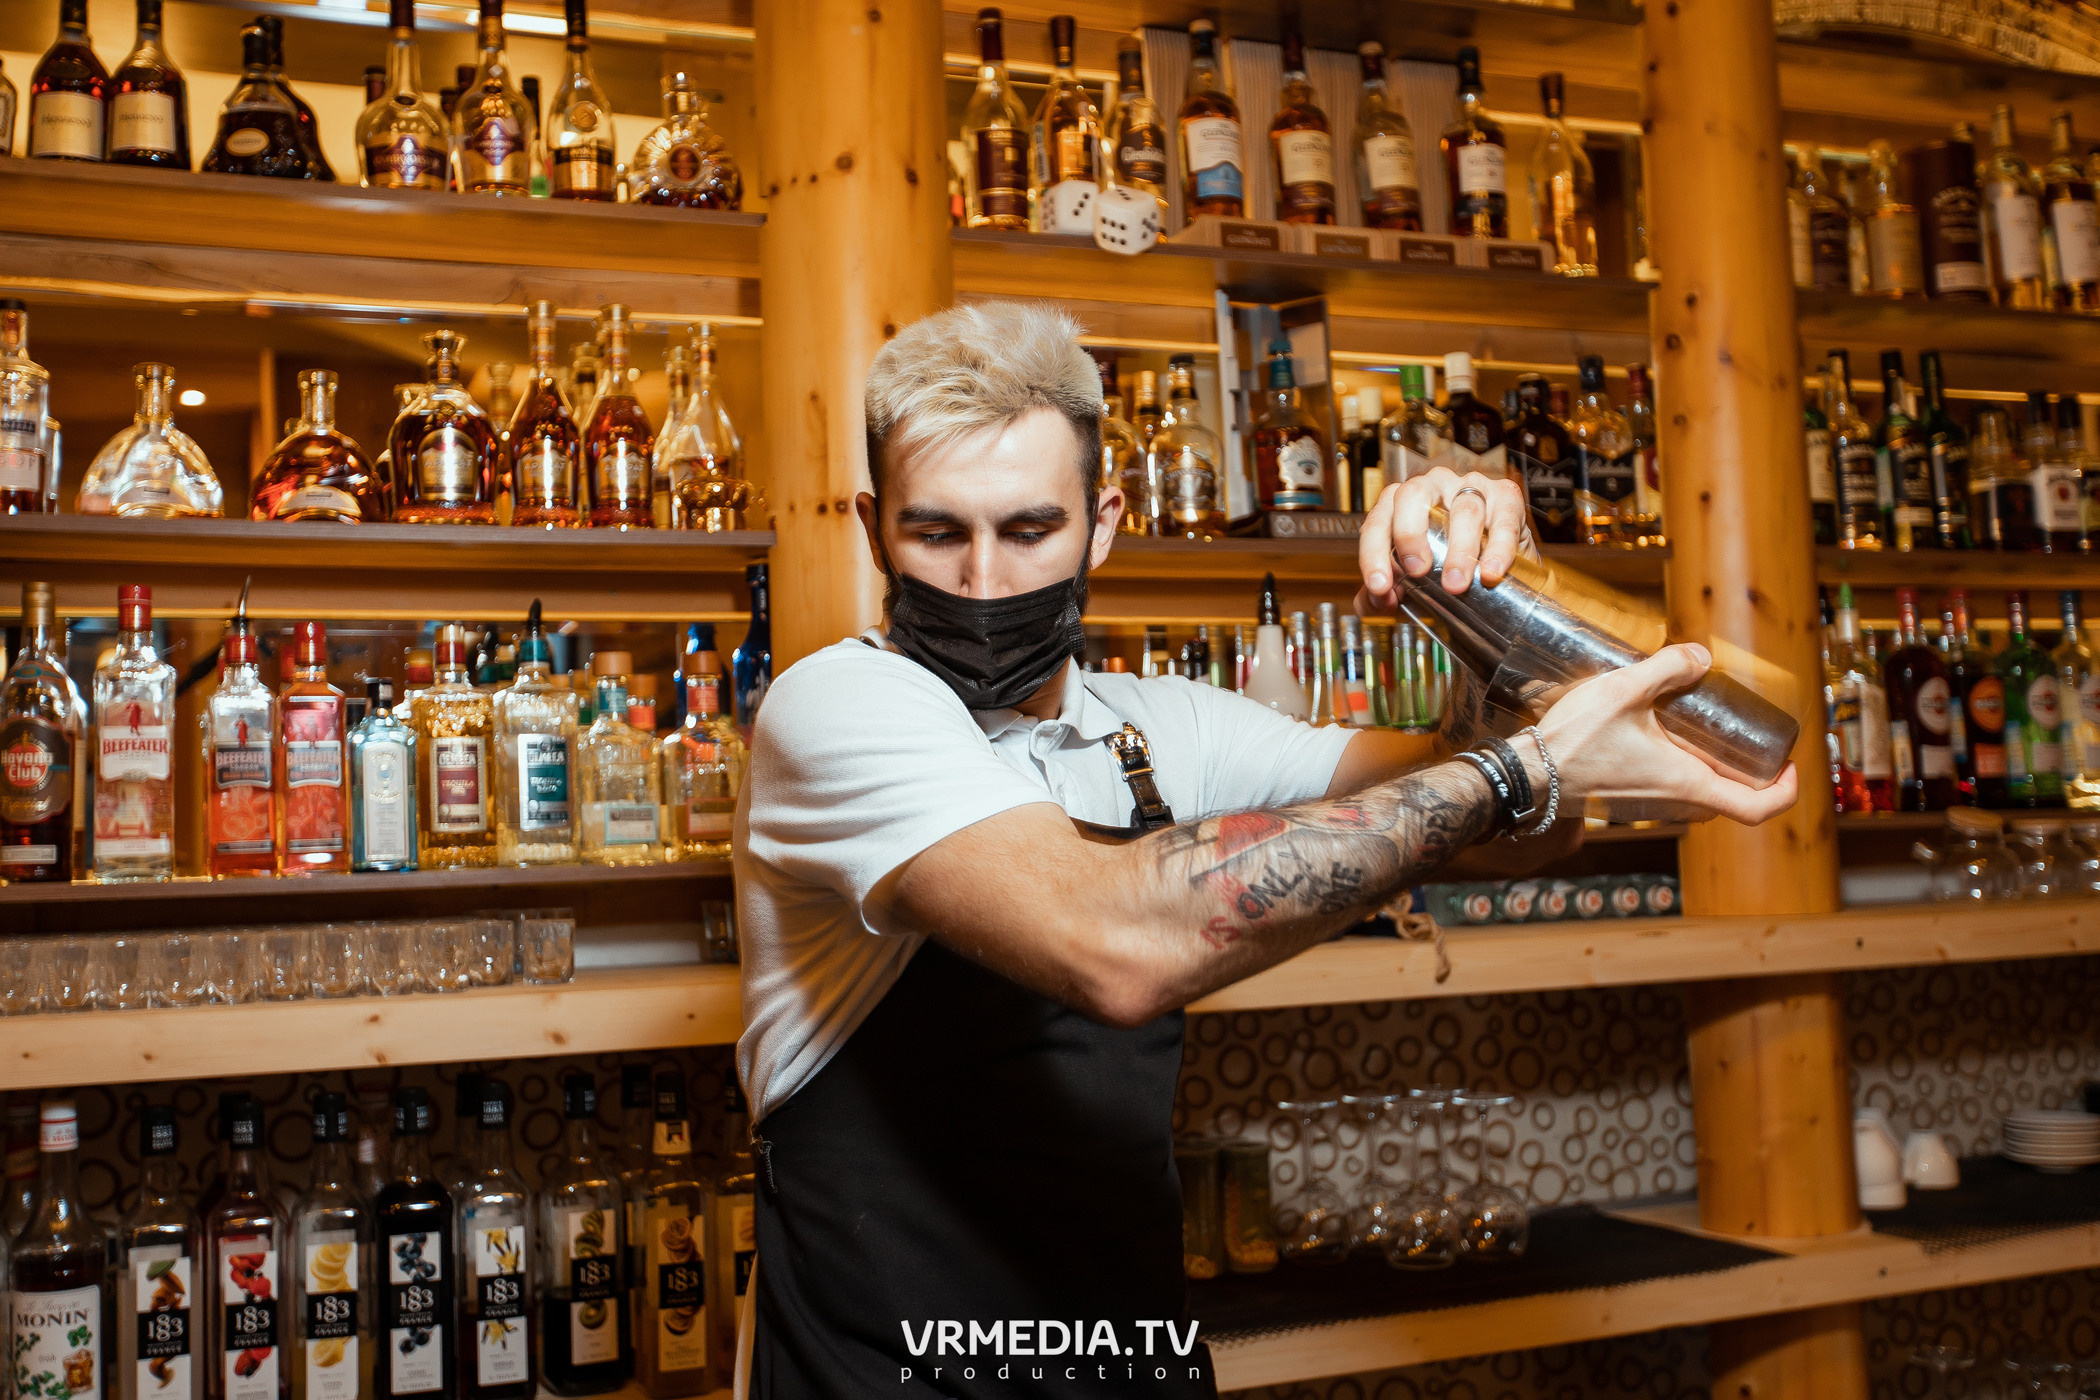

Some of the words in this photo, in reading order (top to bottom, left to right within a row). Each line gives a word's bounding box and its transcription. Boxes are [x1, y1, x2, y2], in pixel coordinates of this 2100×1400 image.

[1303, 516, 1365, 534] CHIVA
[102, 738, 168, 754] BEEFEATER
[216, 751, 271, 766] BEEFEATER
[287, 750, 341, 765] BEEFEATER
[8, 765, 42, 782] Club
[579, 1260, 612, 1286] 1883
[668, 1266, 700, 1293] 1883
[400, 1285, 434, 1312] 1883
[486, 1277, 520, 1305] 1883
[16, 1309, 90, 1328] MONIN
[235, 1305, 271, 1334] 1883
[316, 1295, 350, 1323] 1883
[148, 1313, 184, 1342] 1883
